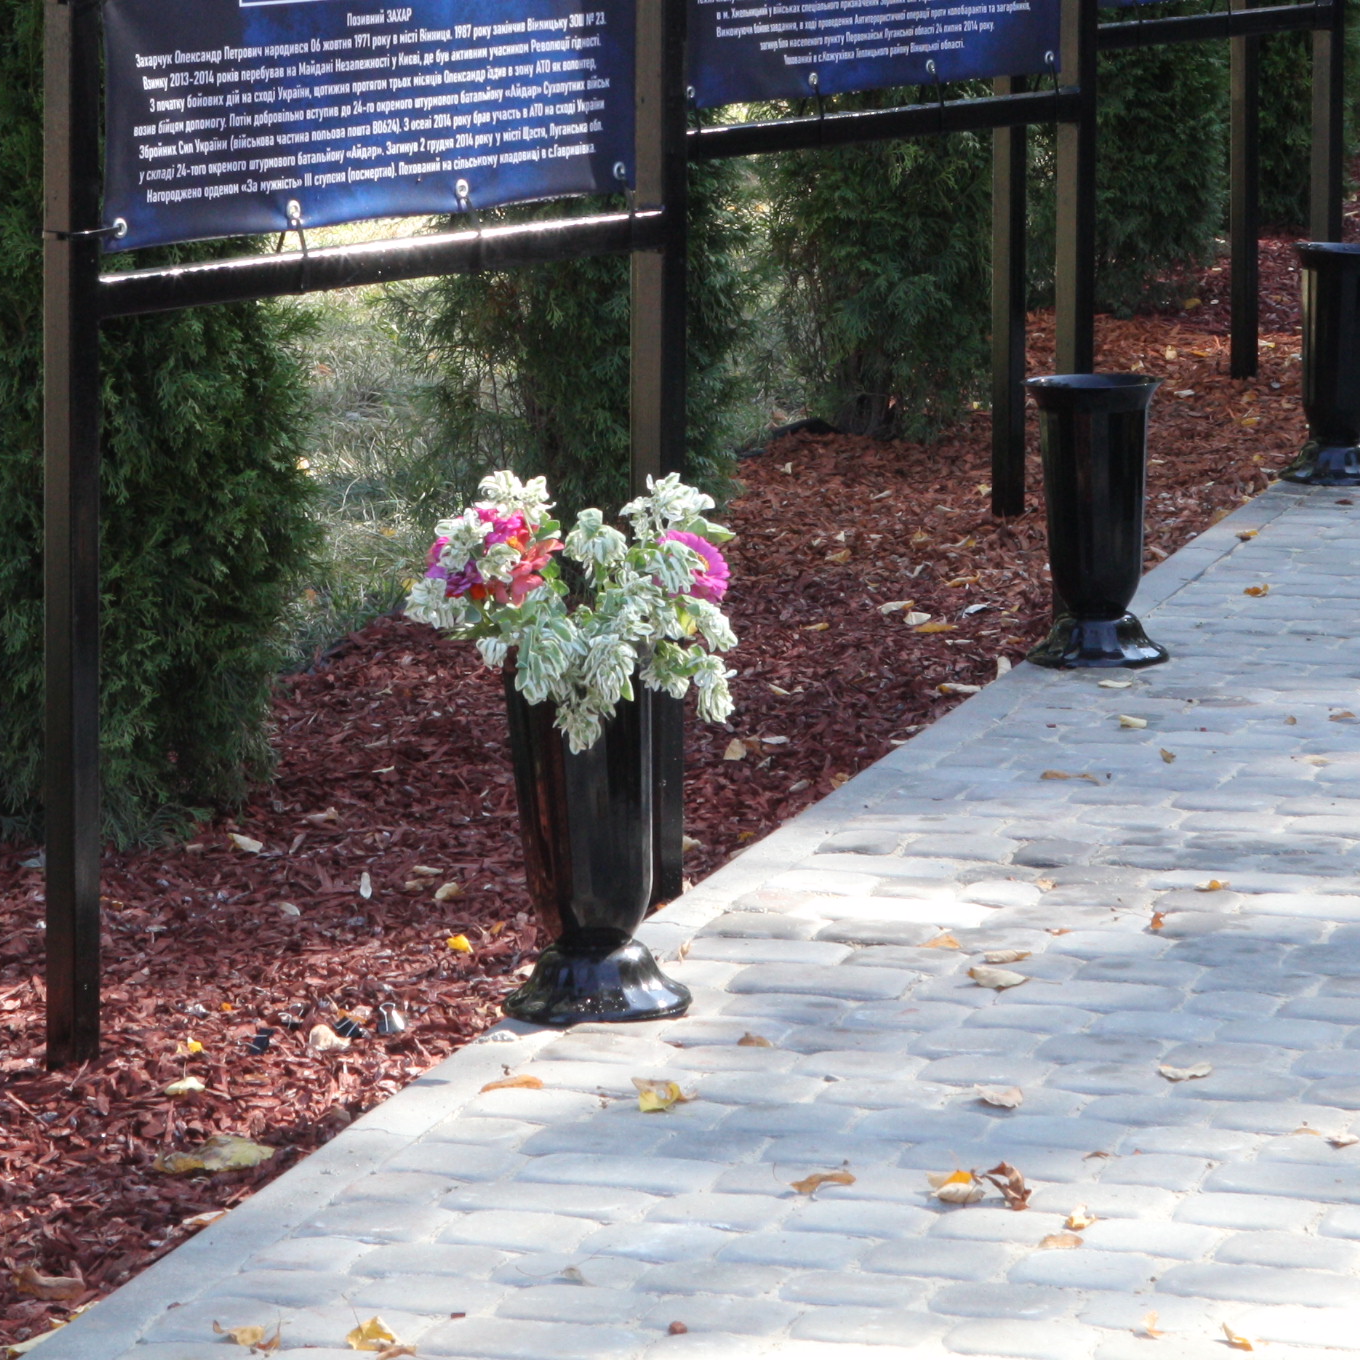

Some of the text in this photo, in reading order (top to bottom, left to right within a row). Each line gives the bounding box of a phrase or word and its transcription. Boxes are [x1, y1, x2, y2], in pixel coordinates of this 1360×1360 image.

[346, 8, 412, 26] Позивний ЗАХАР
[136, 54, 173, 70] Захарчук
[174, 49, 222, 64] Олександр
[224, 46, 263, 62] Петрович
[264, 41, 309, 59] народився
[322, 37, 352, 51] жовтня
[354, 33, 370, 48] 1971
[372, 34, 390, 50] року
[454, 23, 472, 39] 1987
[473, 24, 491, 40] року
[170, 70, 214, 88] 2013-2014
[216, 68, 239, 87] років
[241, 65, 284, 84] перебував
[298, 58, 333, 77] Майдані
[335, 53, 390, 72] Незалежності
[450, 46, 488, 61] активним
[489, 42, 529, 60] учасником
[186, 93, 224, 109] бойових
[254, 86, 276, 103] сході
[352, 78, 387, 95] протягом
[389, 76, 412, 92] трьох
[444, 69, 486, 83] Олександр
[514, 64, 534, 79] зону
[253, 107, 304, 127] добровільно
[306, 105, 339, 121] вступив
[376, 97, 413, 114] окремого
[195, 137, 228, 156] України
[276, 130, 310, 144] частина
[208, 159, 246, 177] окремого
[386, 140, 419, 155] Загинув
[146, 186, 202, 204] Нагороджено
[203, 182, 239, 199] орденом
